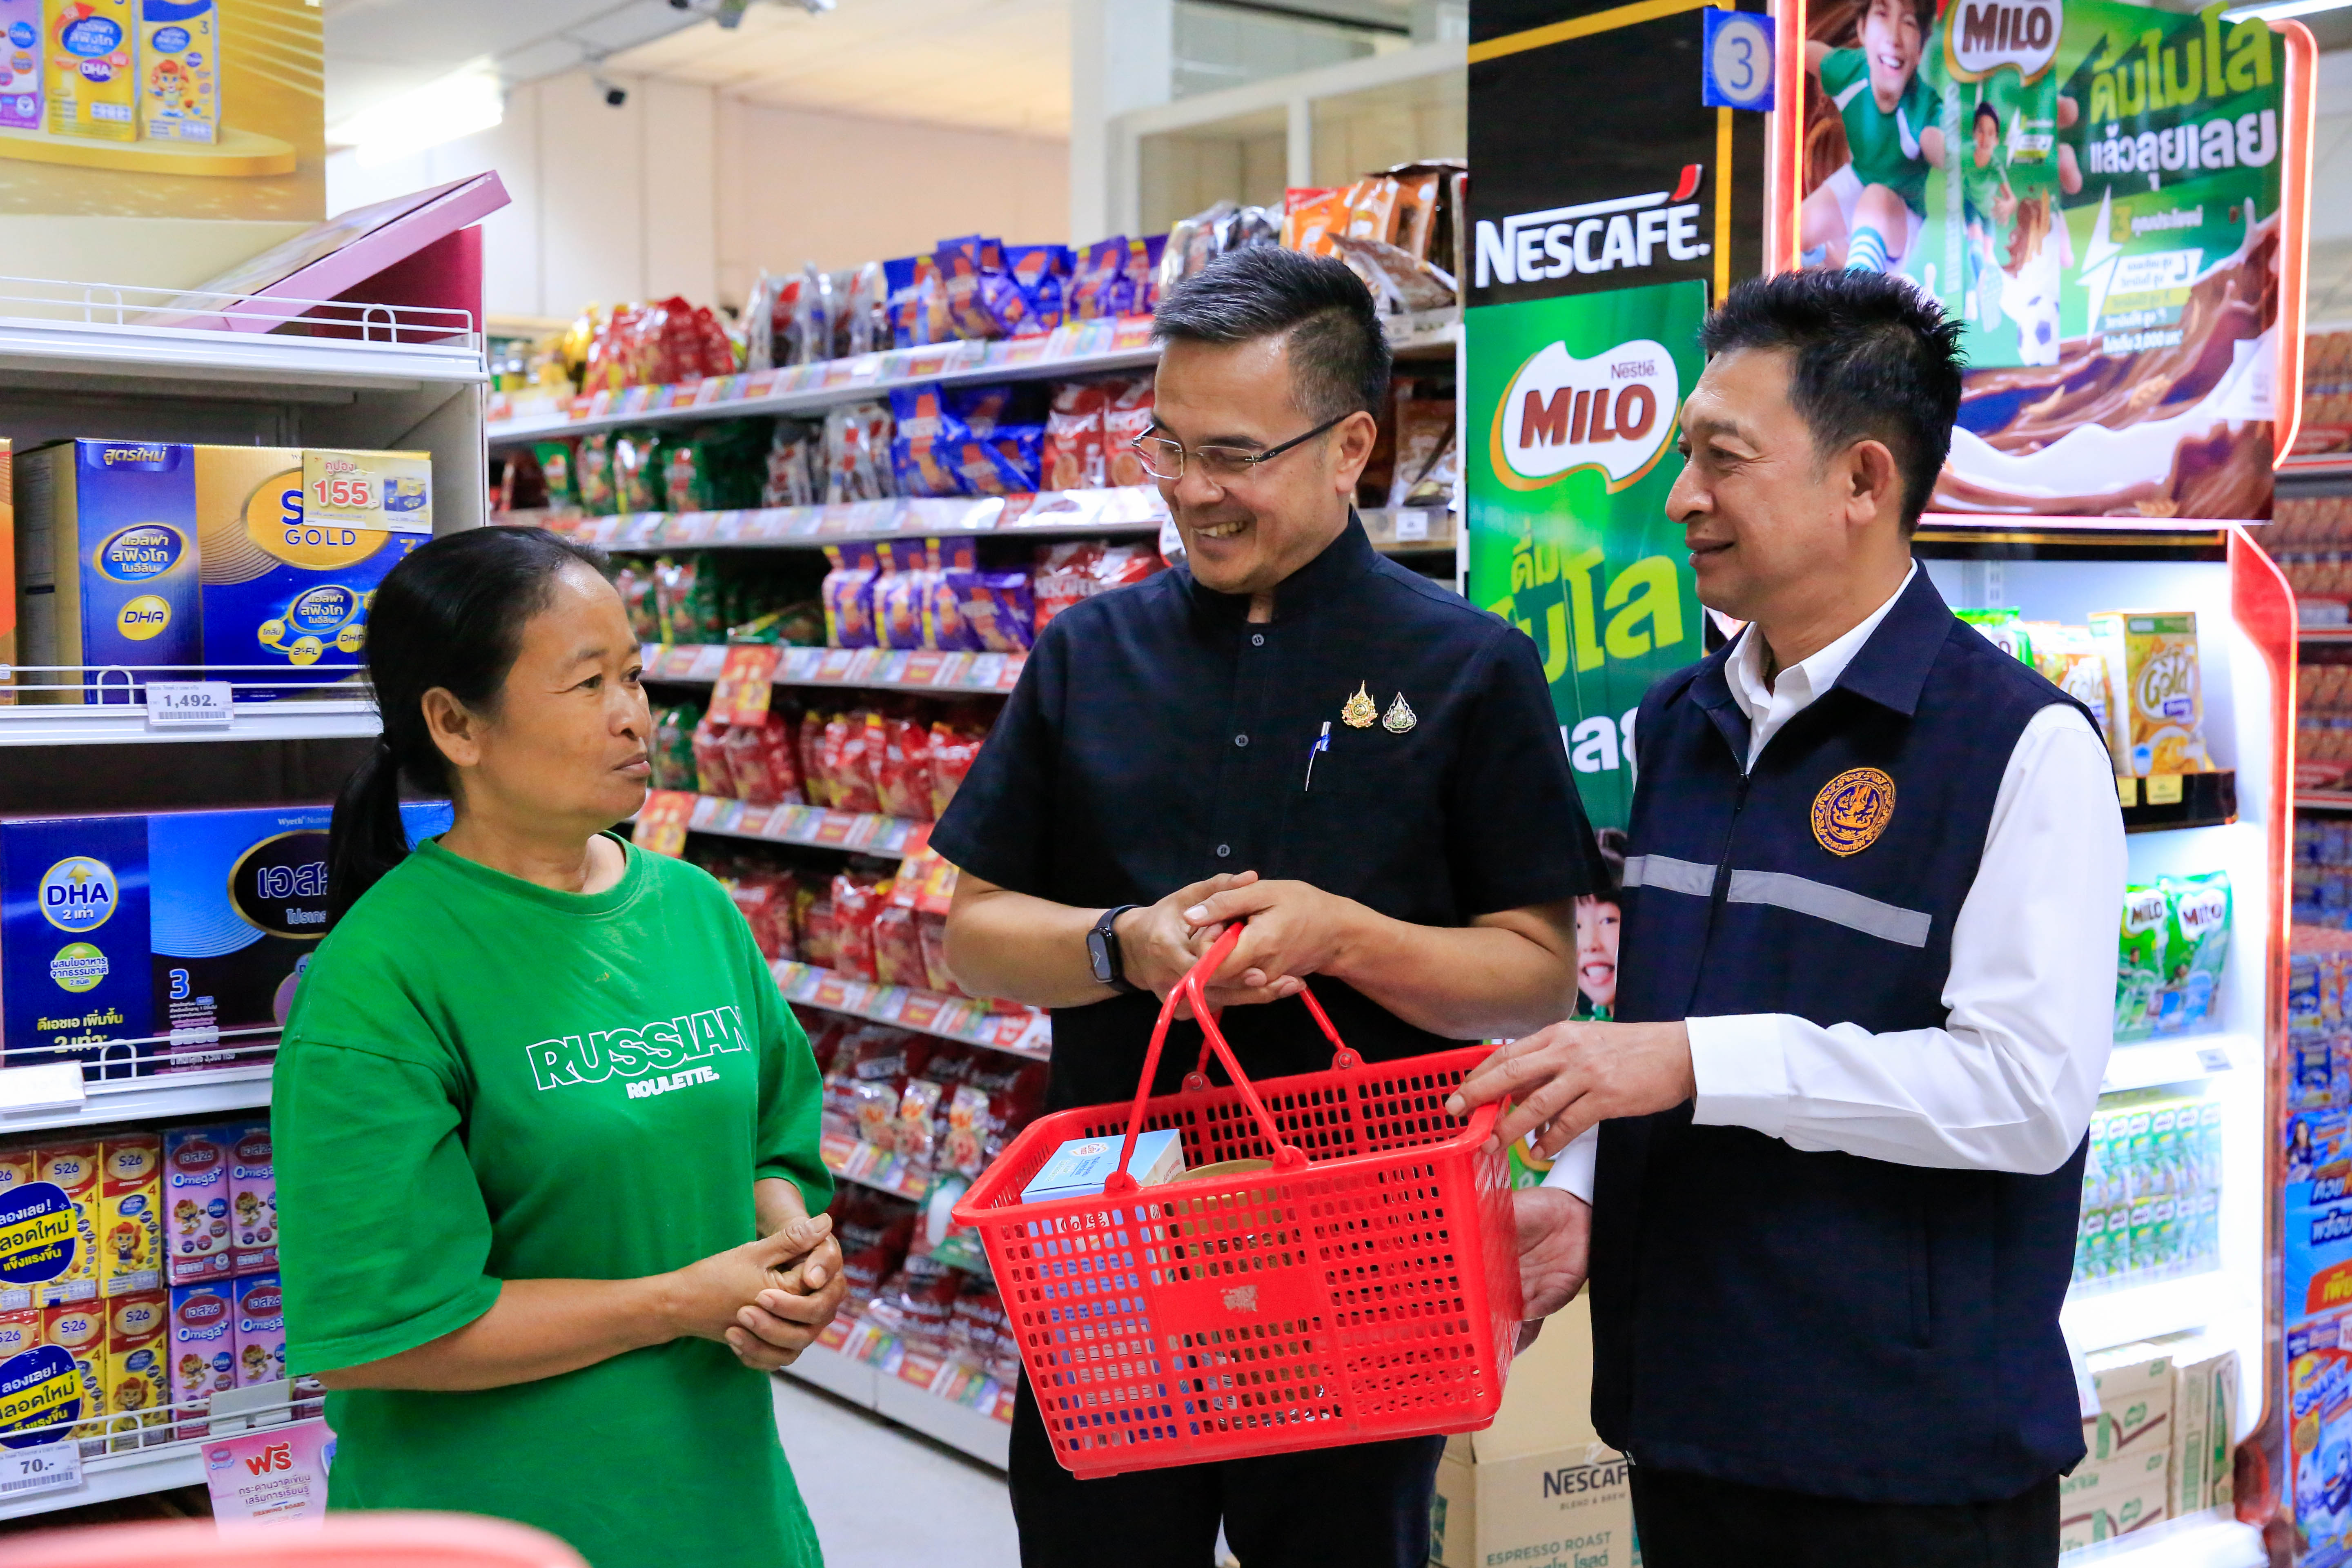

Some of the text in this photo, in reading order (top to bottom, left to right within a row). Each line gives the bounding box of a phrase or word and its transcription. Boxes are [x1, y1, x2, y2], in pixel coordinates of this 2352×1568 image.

[200, 21, 209, 34] 3
[1962, 3, 2052, 52] MILO
[81, 63, 111, 76] DHA
[1731, 36, 1753, 90] 3
[2090, 109, 2277, 191] แล้วลุยเลย
[1519, 384, 1656, 448] MILO
[103, 448, 166, 466] สูตรใหม่
[325, 461, 355, 474] คูปอง
[122, 535, 169, 547] แอลฟา
[285, 530, 356, 546] GOLD
[111, 548, 168, 563] สฟิงโก
[1512, 518, 1560, 593] ดื่ม
[308, 594, 344, 603] แอลฟา
[124, 611, 164, 624] DHA
[301, 604, 343, 615] สฟิงโก
[2145, 652, 2189, 709] Gold
[258, 861, 327, 899] เอส
[47, 882, 109, 906] DHA
[63, 906, 94, 920] 2 เท่า
[52, 957, 107, 968] ผสมใยอาหาร
[52, 965, 107, 978] จากธรรมชาติ
[169, 968, 190, 1000] 3
[37, 1007, 123, 1031] ดีเอชเอ เพิ่มขึ้น
[526, 1006, 750, 1091] RUSSIAN
[233, 1165, 275, 1180] Omega
[85, 1193, 94, 1203] 4
[147, 1185, 156, 1195] 4
[0, 1214, 69, 1251] ลอดใหม่
[3, 1244, 62, 1271] แข็งแรงขึ้น
[241, 1316, 284, 1332] Omega
[155, 1339, 163, 1350] 4
[92, 1350, 101, 1361] 4
[2, 1362, 57, 1393] ลองเลย!
[0, 1375, 74, 1419] ลอดใหม่
[246, 1442, 292, 1476] ฟรี
[239, 1475, 310, 1495] กระดานวาดเขียน
[1544, 1458, 1628, 1499] NESCAF
[253, 1502, 305, 1517] DRAWING BOARD
[1560, 1499, 1588, 1510] BLEND
[1601, 1492, 1626, 1503] BREW
[1487, 1541, 1560, 1566] ESPRESSO
[1565, 1531, 1611, 1550] ROAST
